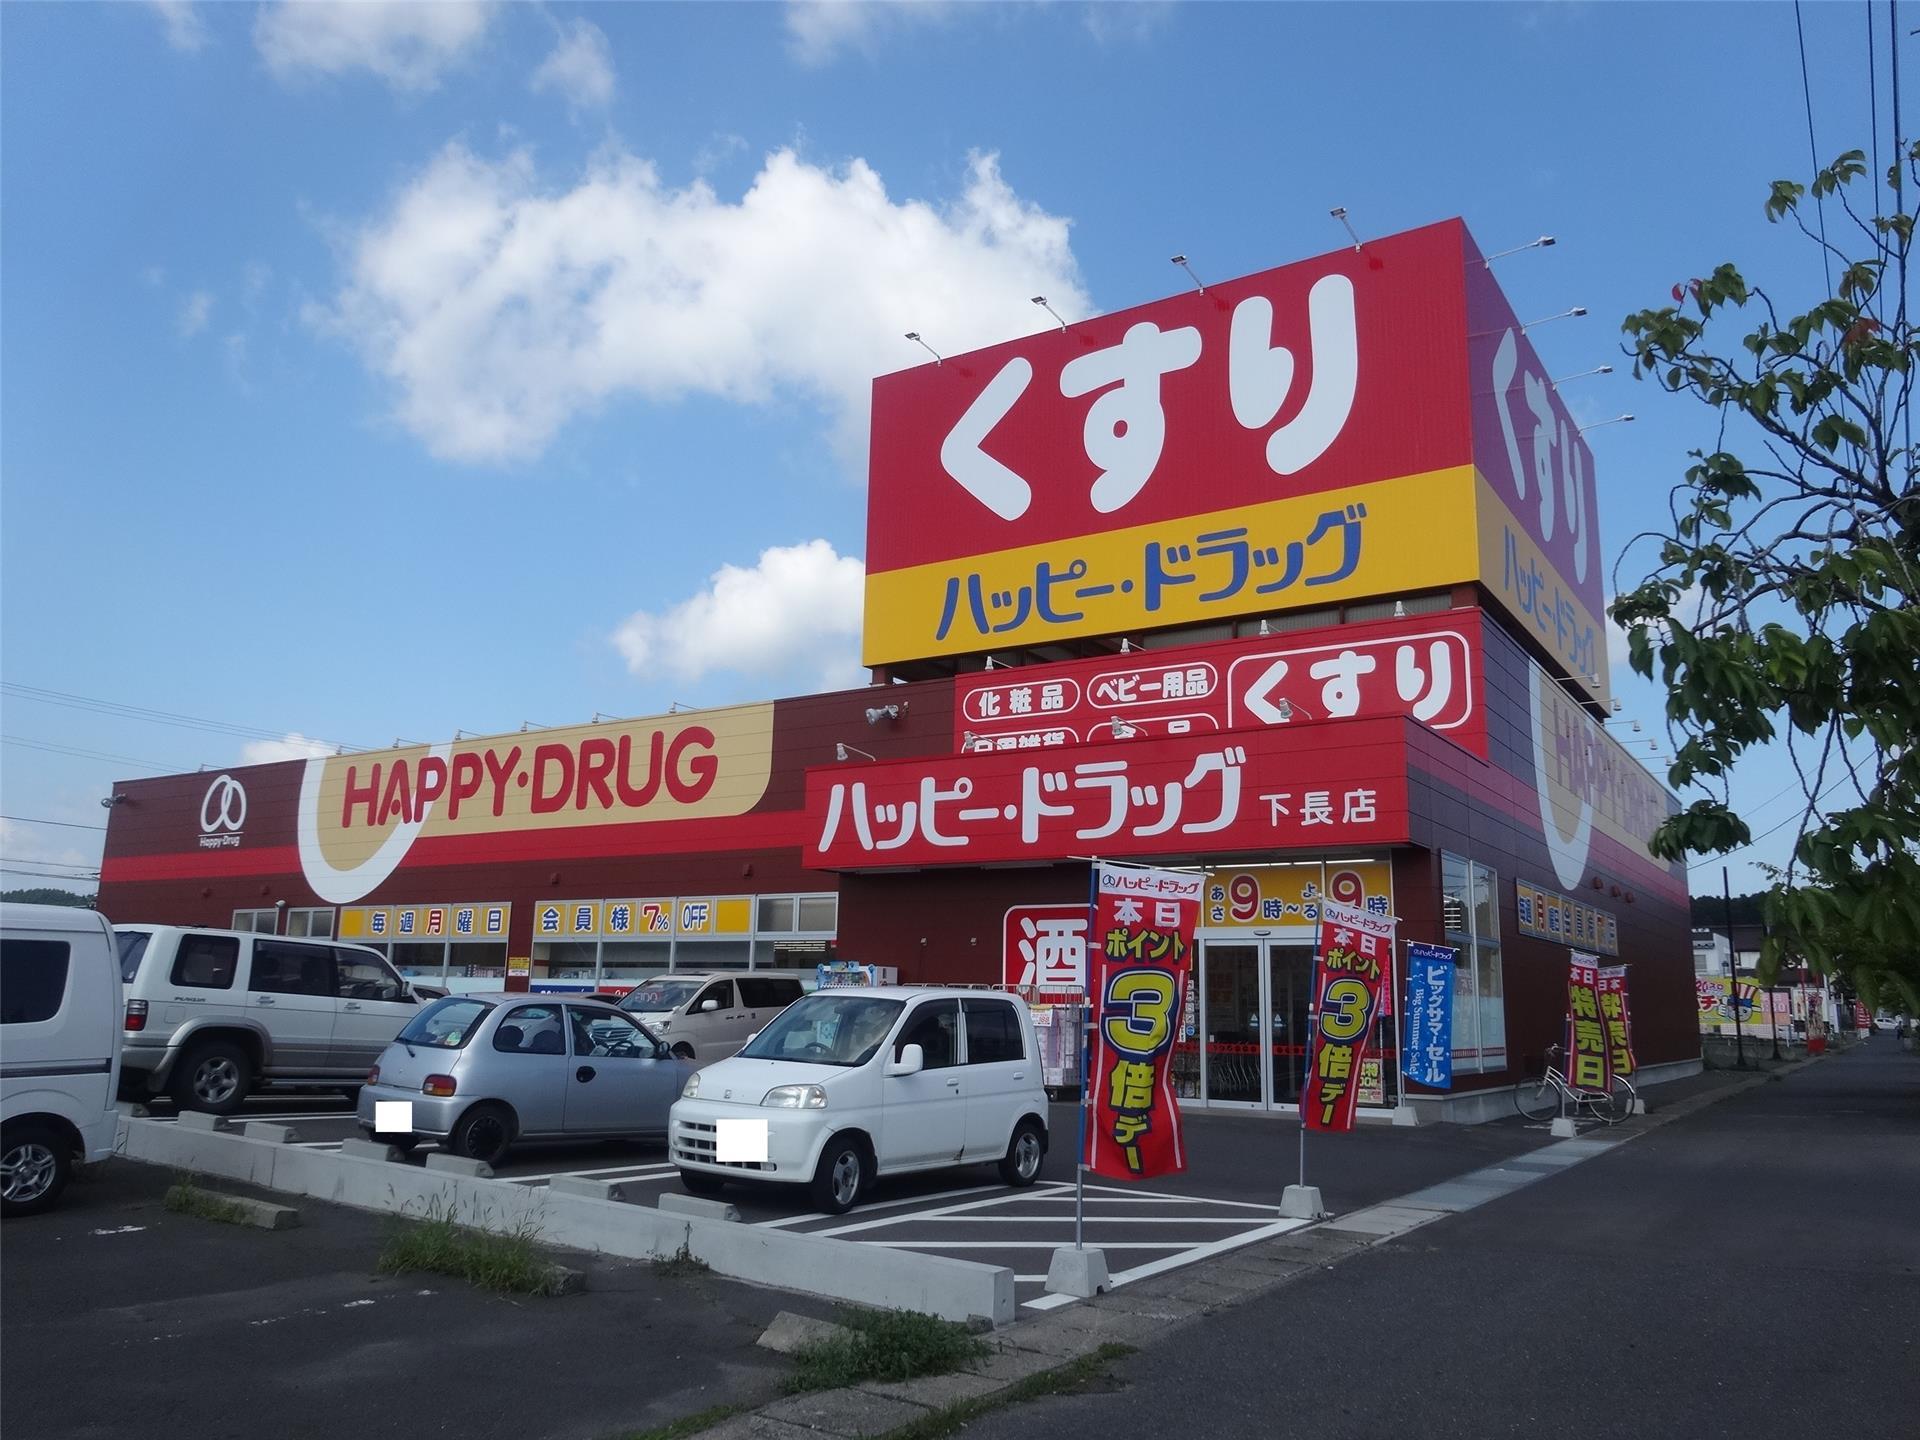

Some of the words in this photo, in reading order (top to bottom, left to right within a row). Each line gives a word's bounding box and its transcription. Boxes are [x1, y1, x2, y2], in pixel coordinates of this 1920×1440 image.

[941, 274, 1358, 521] くすり
[1493, 327, 1587, 584] くすり
[936, 503, 1367, 641] ハッピー・ドラッグ
[1096, 668, 1208, 702] ベビー用品
[1244, 641, 1452, 725] くすり
[978, 684, 1064, 717] 化粧品
[818, 746, 1246, 853] ハッピー・ドラッグ
[1259, 789, 1377, 828] 下長店
[1115, 876, 1200, 895] ハッピー・ドラッグ
[372, 909, 502, 934] 毎週月曜日
[1113, 898, 1181, 928] 本日
[1018, 917, 1088, 995] 酒
[1106, 929, 1184, 960] ポイント
[1333, 927, 1377, 957] 本日
[1326, 947, 1381, 980] ポイント
[1570, 966, 1594, 985] 本日
[1412, 988, 1425, 1006] Big
[1411, 1007, 1424, 1050] Summer
[1425, 965, 1448, 1083] ビッグサマーセール
[1570, 985, 1605, 1088] 特売日
[1408, 1051, 1421, 1076] Sale!
